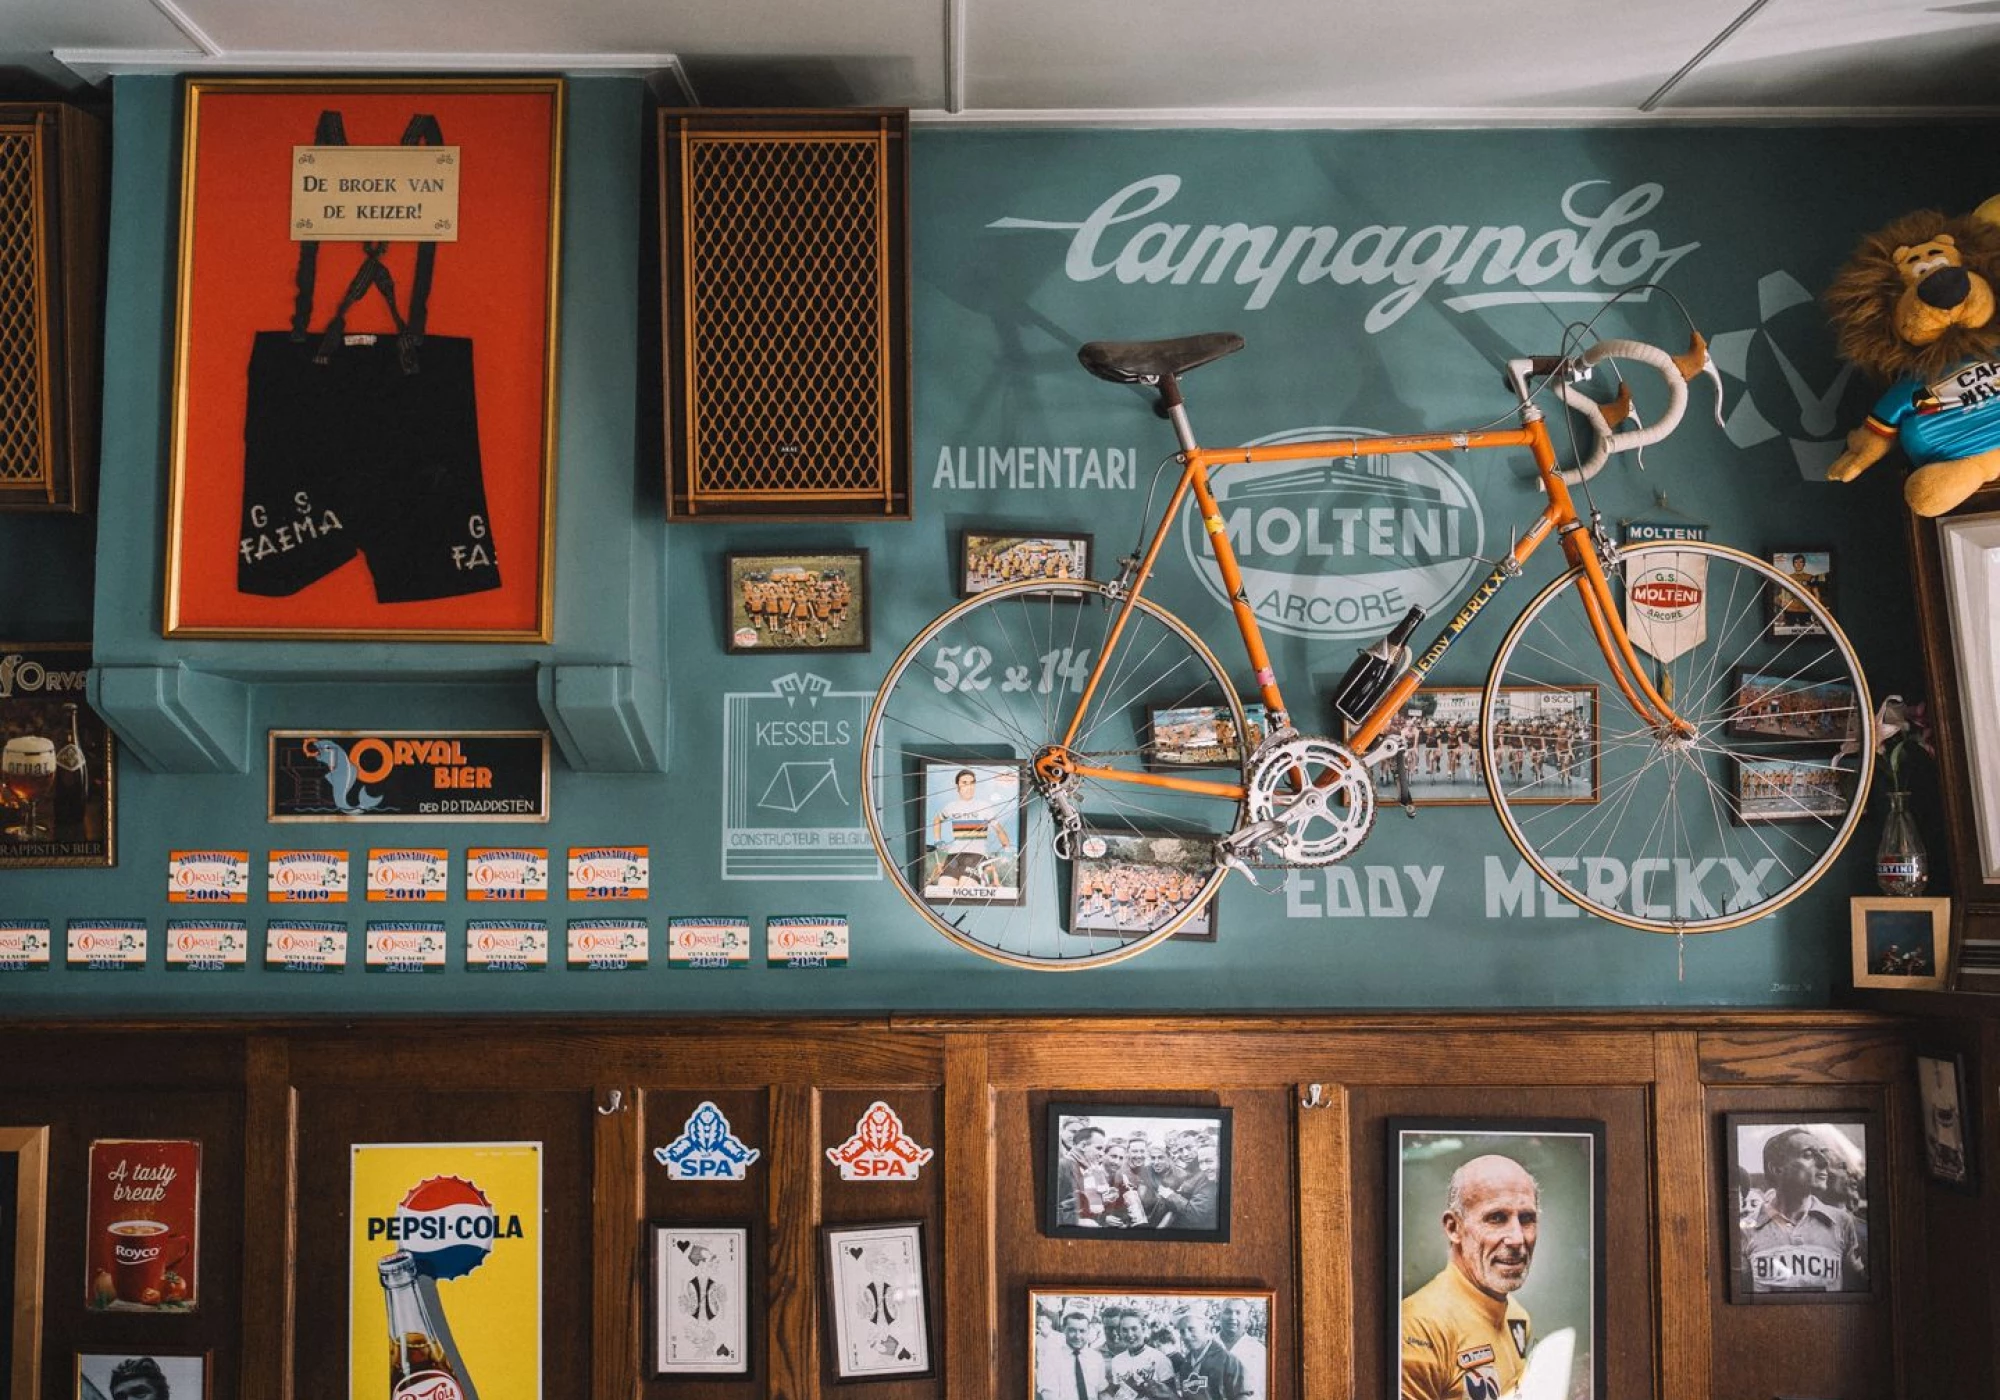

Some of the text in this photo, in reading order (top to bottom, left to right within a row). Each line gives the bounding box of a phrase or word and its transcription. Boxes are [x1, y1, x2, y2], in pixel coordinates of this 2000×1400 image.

[339, 176, 397, 193] BROEK
[409, 177, 445, 193] VAN
[322, 202, 423, 220] DE KEIZER!
[985, 173, 1701, 334] Campagnolo
[933, 445, 1137, 490] ALIMENTARI
[251, 491, 313, 529] G S
[239, 508, 344, 564] FAEMA
[468, 514, 486, 538] G
[1202, 506, 1461, 558] MOLTENI
[1630, 526, 1703, 541] MOLTENI
[451, 545, 499, 572] FA
[1633, 587, 1699, 603] MOLTENI
[1259, 586, 1407, 627] ARCORE
[1647, 608, 1684, 621] ARCORE
[1417, 570, 1507, 672] EDDY MERCKX
[933, 645, 993, 693] 52
[1038, 647, 1090, 693] 14
[755, 720, 851, 746] KESSELS
[349, 738, 467, 784] ORVAL
[434, 766, 492, 789] BIER
[419, 802, 439, 813] DER
[731, 832, 820, 846] CONSTRUCTEUR
[186, 888, 231, 900] 2008
[286, 888, 330, 900] 2009
[385, 887, 427, 900] 2010
[484, 887, 527, 900] 2011
[586, 885, 630, 898] 2012
[1286, 855, 1778, 919] EDDY MERCKX
[108, 1159, 177, 1187] A tasty
[680, 1158, 734, 1178] SPA
[853, 1158, 907, 1178] SPA
[113, 1183, 166, 1202] break
[116, 1244, 160, 1260] Royco
